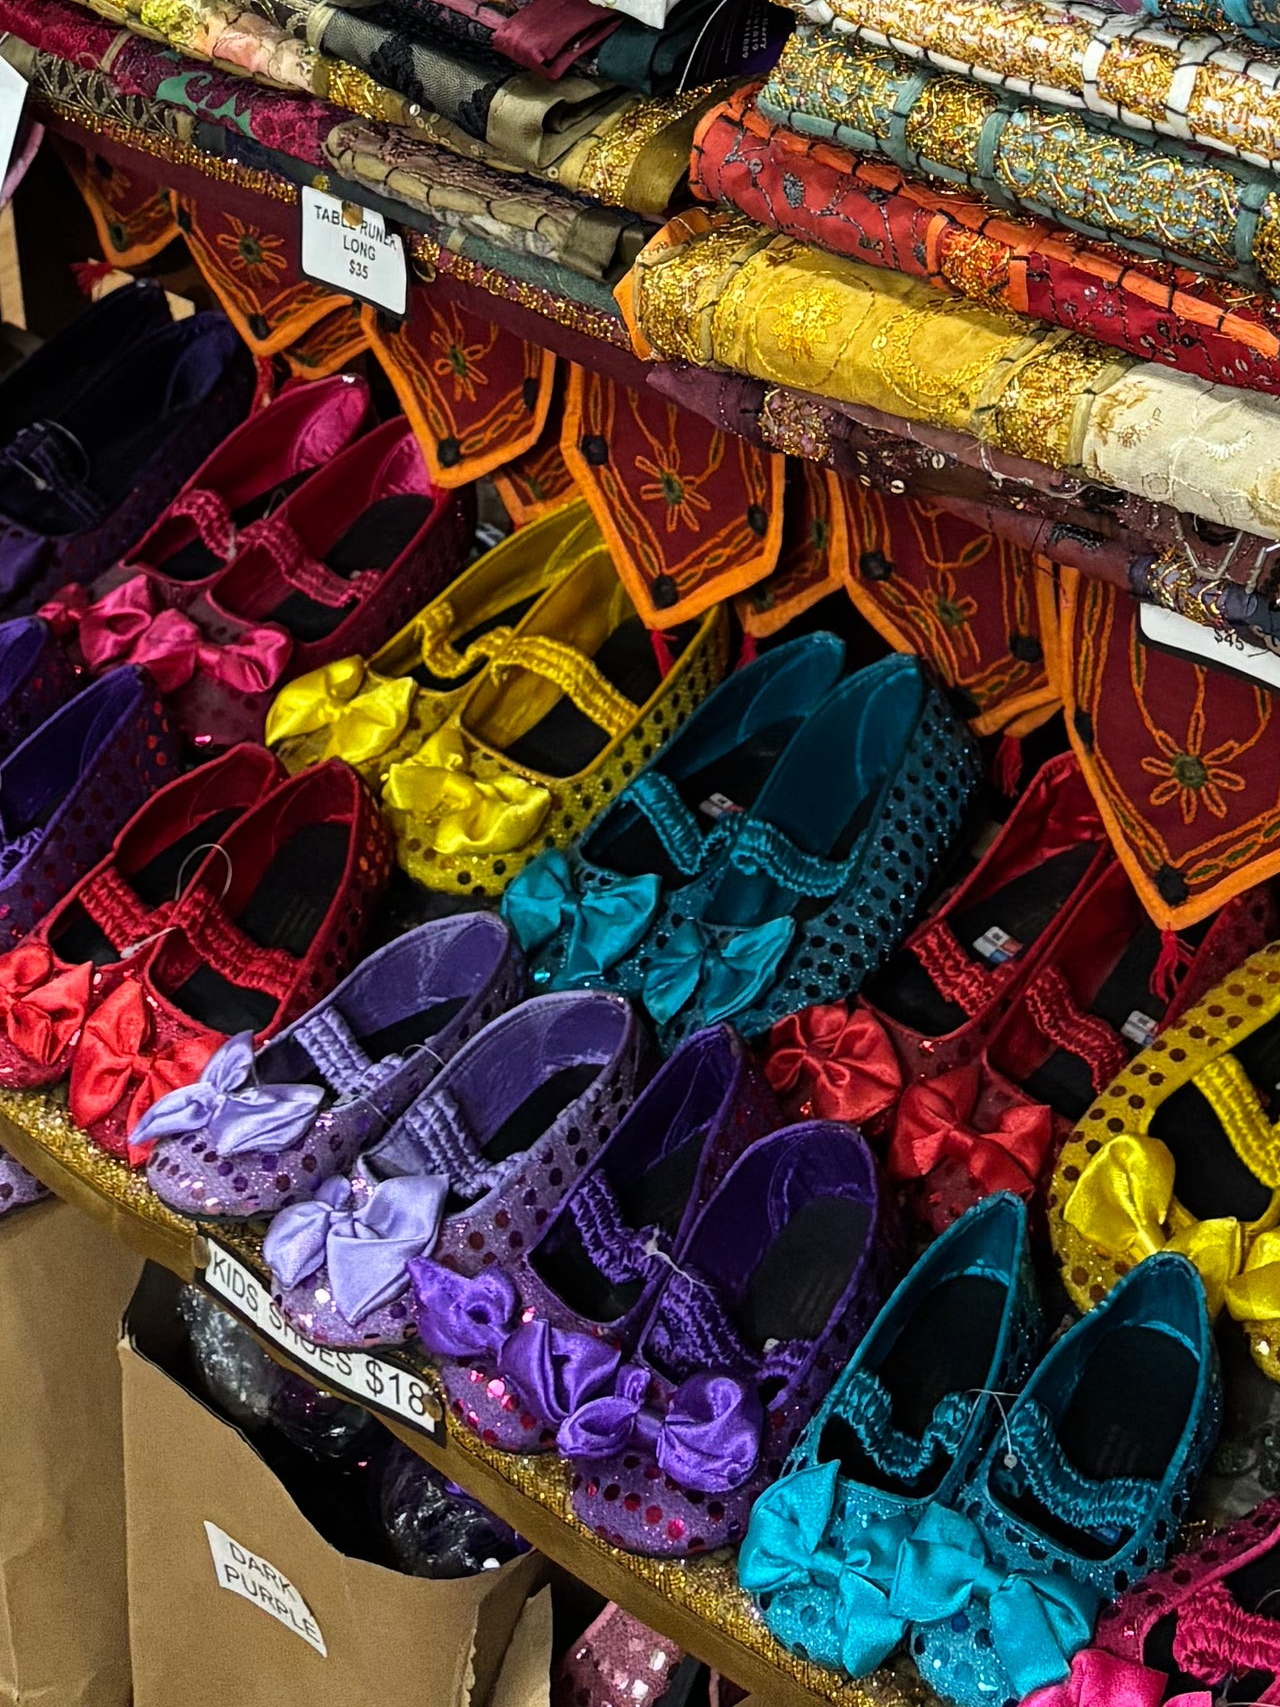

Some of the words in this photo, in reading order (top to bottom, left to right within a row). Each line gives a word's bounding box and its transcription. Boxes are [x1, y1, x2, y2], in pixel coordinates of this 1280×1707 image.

[343, 235, 376, 261] LONG
[349, 259, 369, 280] $35
[212, 1251, 259, 1313] KIDS
[365, 1359, 427, 1417] $18
[229, 1541, 297, 1602] DARK
[225, 1563, 320, 1644] PURPLE
